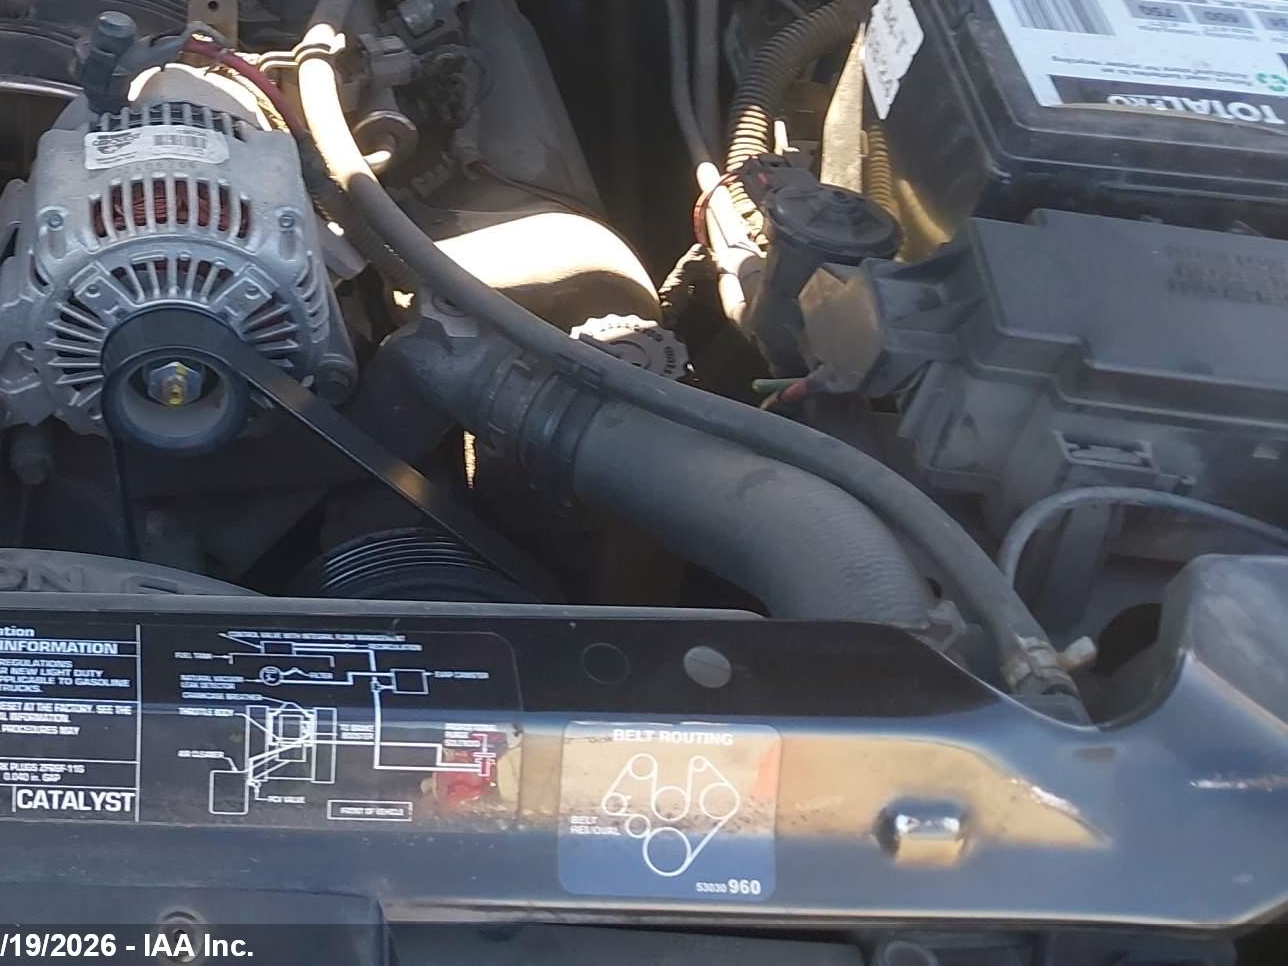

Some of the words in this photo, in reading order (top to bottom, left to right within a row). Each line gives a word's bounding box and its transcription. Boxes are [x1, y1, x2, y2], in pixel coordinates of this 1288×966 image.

[10, 666, 36, 675] NEW
[39, 667, 70, 676] LIGHT
[72, 668, 102, 677] DUTY
[58, 676, 72, 685] TO
[74, 677, 129, 687] GASOLINE
[613, 729, 655, 742] BELT
[659, 731, 735, 745] ROUTING
[16, 788, 135, 812] CATALYST
[727, 879, 761, 895] 960
